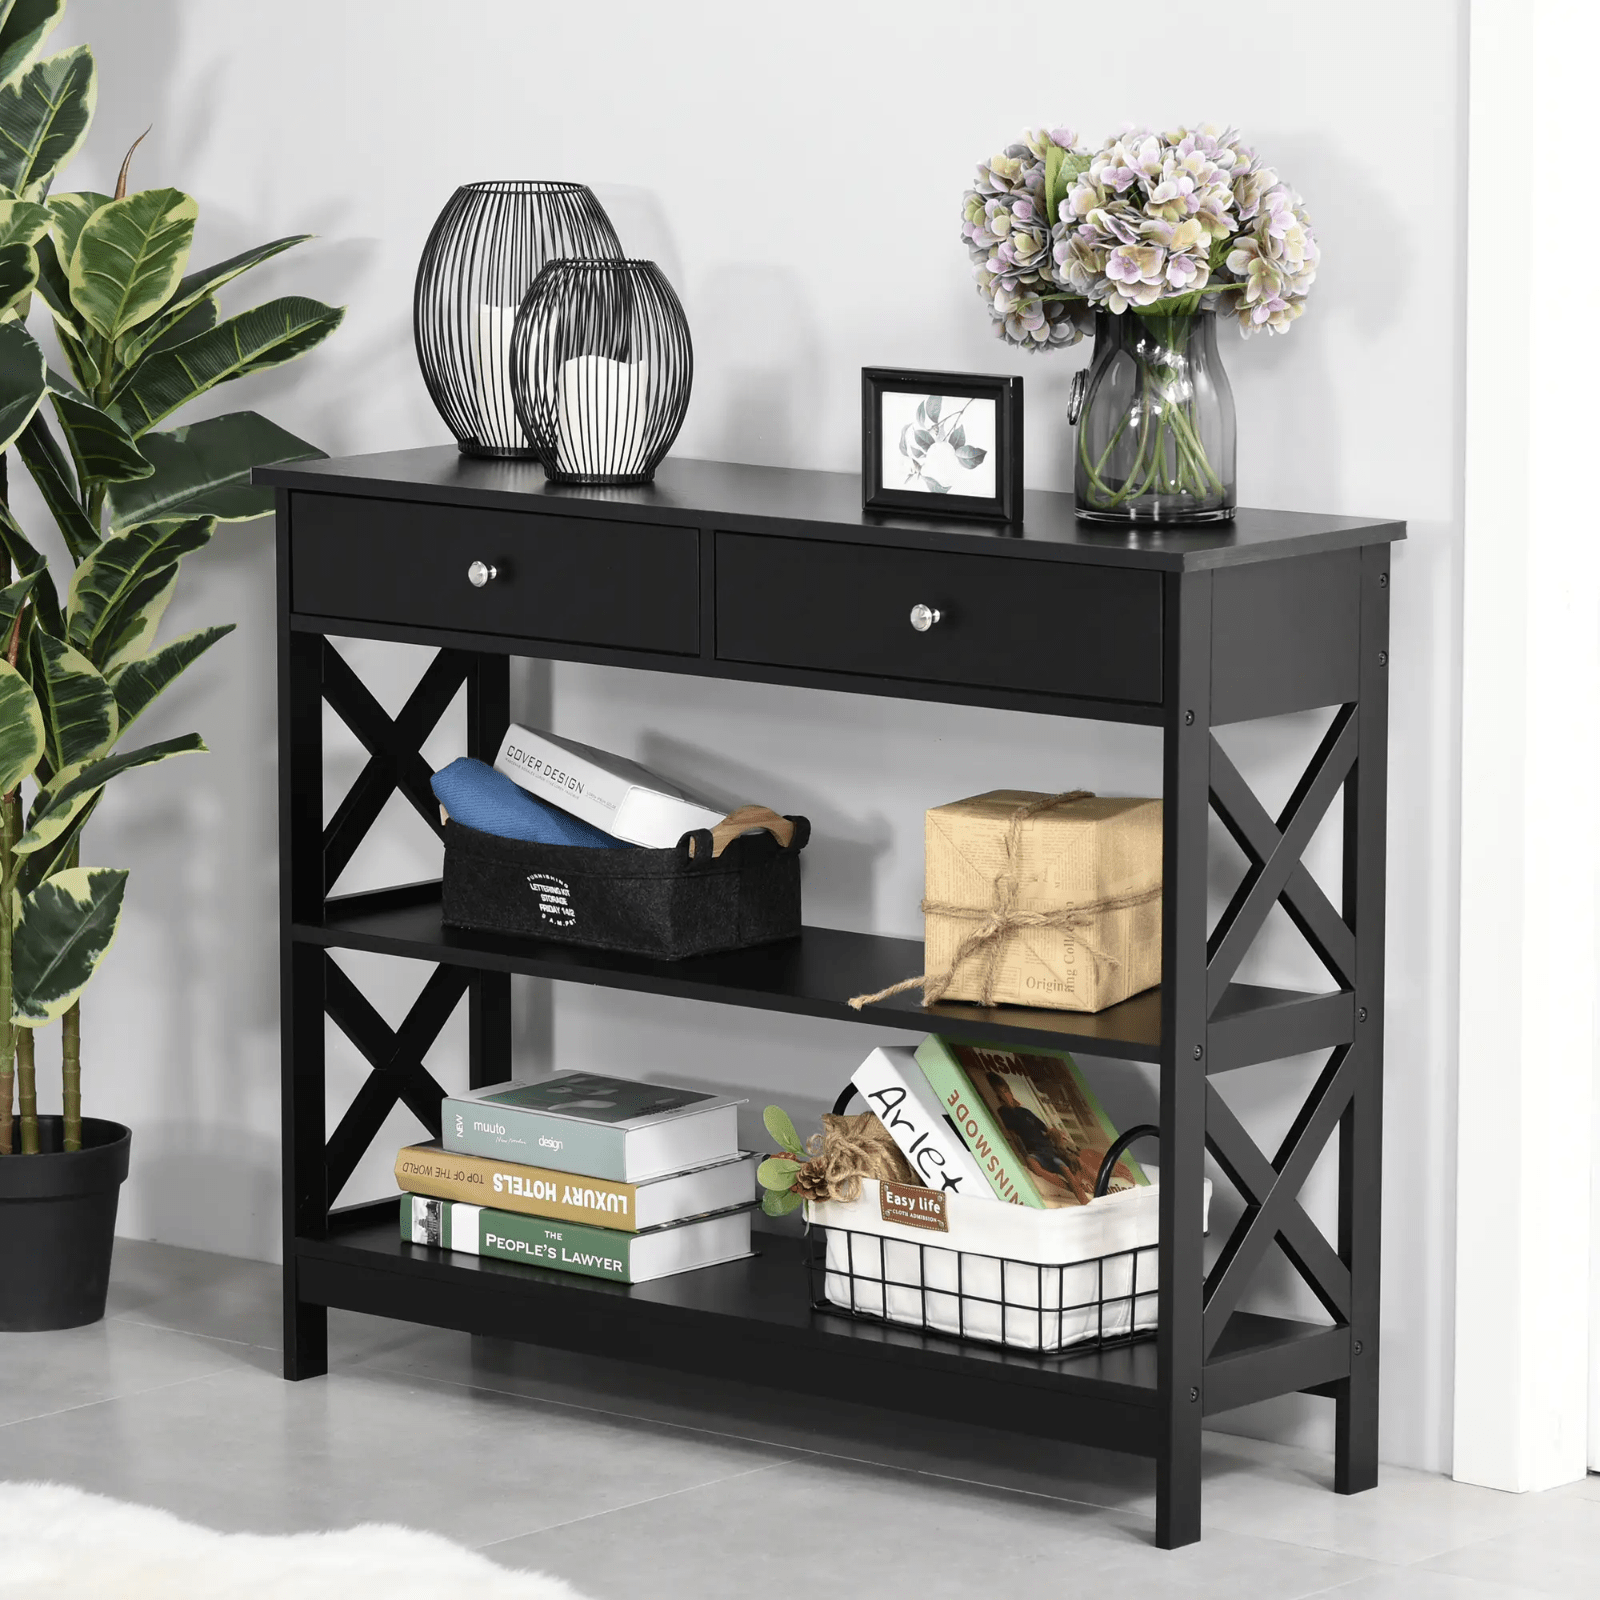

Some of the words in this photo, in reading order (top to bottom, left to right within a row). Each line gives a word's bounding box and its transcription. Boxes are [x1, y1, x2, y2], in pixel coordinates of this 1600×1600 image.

[506, 745, 543, 772] COVER
[543, 764, 585, 794] DESIGN
[455, 1114, 464, 1138] NEW
[473, 1121, 506, 1135] muuto
[538, 1135, 564, 1152] design
[402, 1162, 433, 1177] WORLD
[434, 1166, 451, 1180] THE
[453, 1170, 465, 1182] OF
[466, 1173, 485, 1185] TOP
[493, 1173, 557, 1202] HOTELS
[561, 1185, 628, 1215] LUXURY
[886, 1191, 916, 1211] Easy
[918, 1196, 941, 1214] life
[892, 1209, 909, 1217] CLOTH
[909, 1213, 937, 1223] ADMISSION
[544, 1230, 563, 1241] THE
[485, 1233, 557, 1259] PEOPLE'S
[561, 1248, 623, 1273] LAWYER
